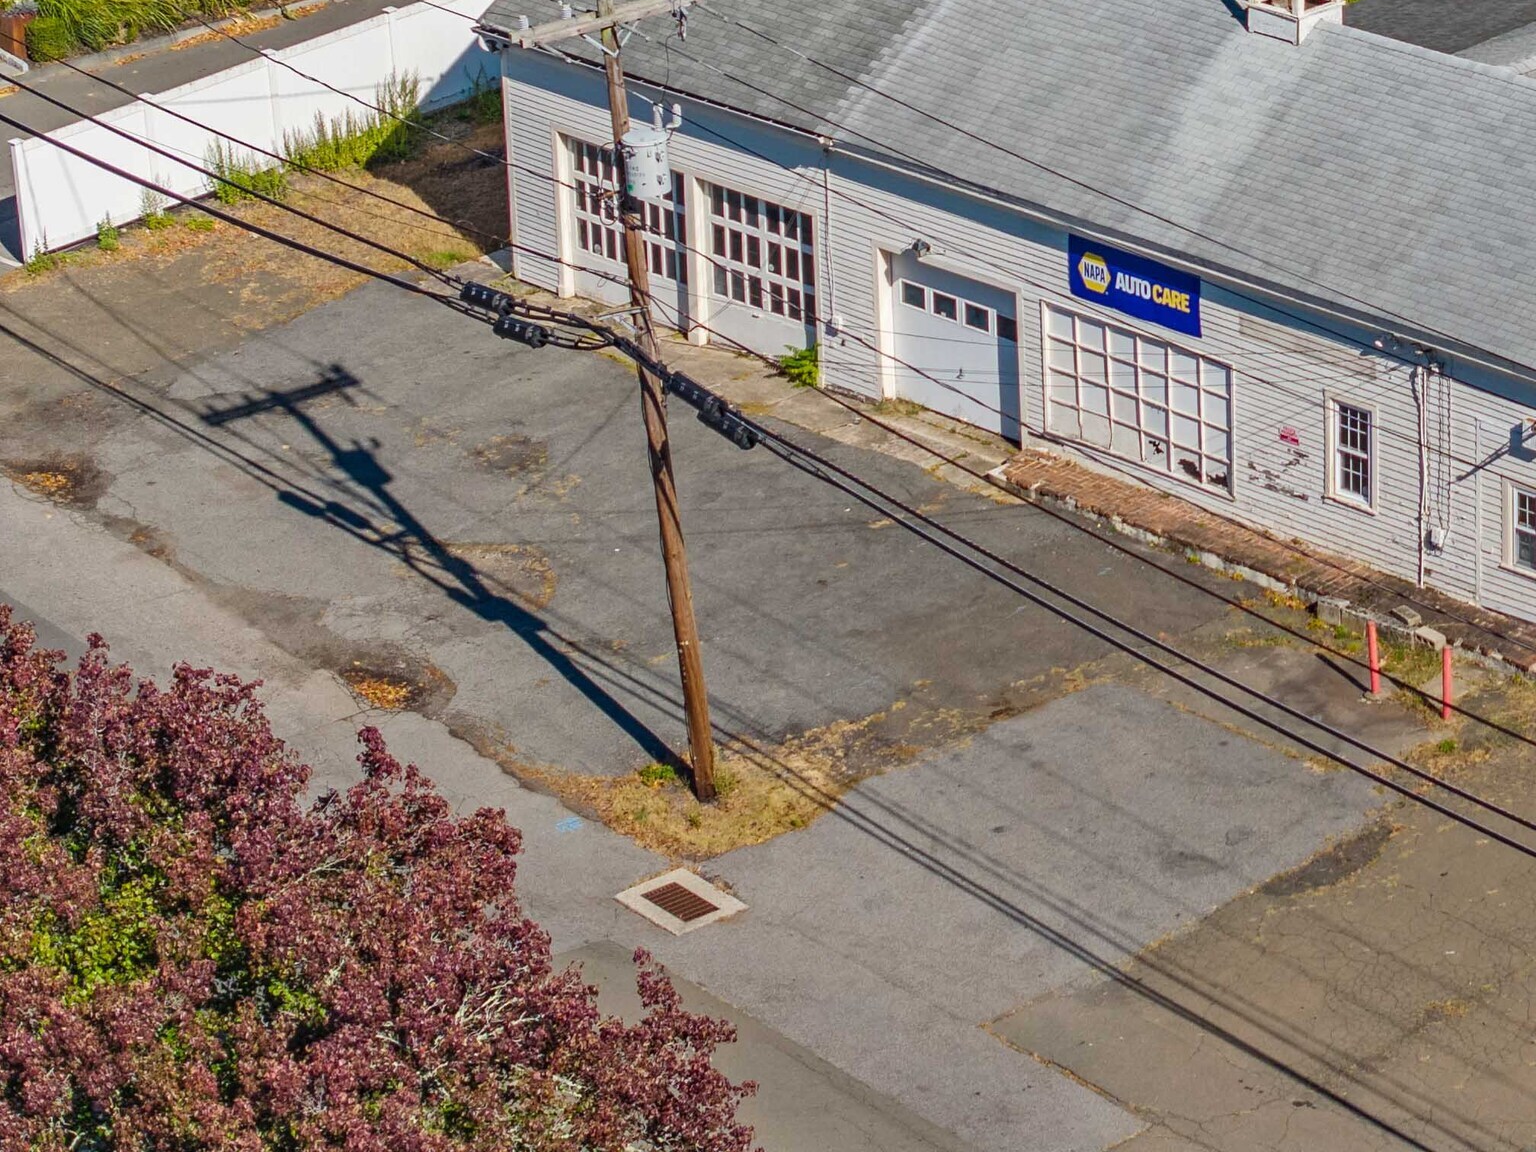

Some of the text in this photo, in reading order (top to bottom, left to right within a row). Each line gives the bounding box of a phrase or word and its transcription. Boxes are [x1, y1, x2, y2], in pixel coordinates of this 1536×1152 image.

[1083, 261, 1105, 284] NAPA
[1115, 271, 1191, 313] AUTO CARE
